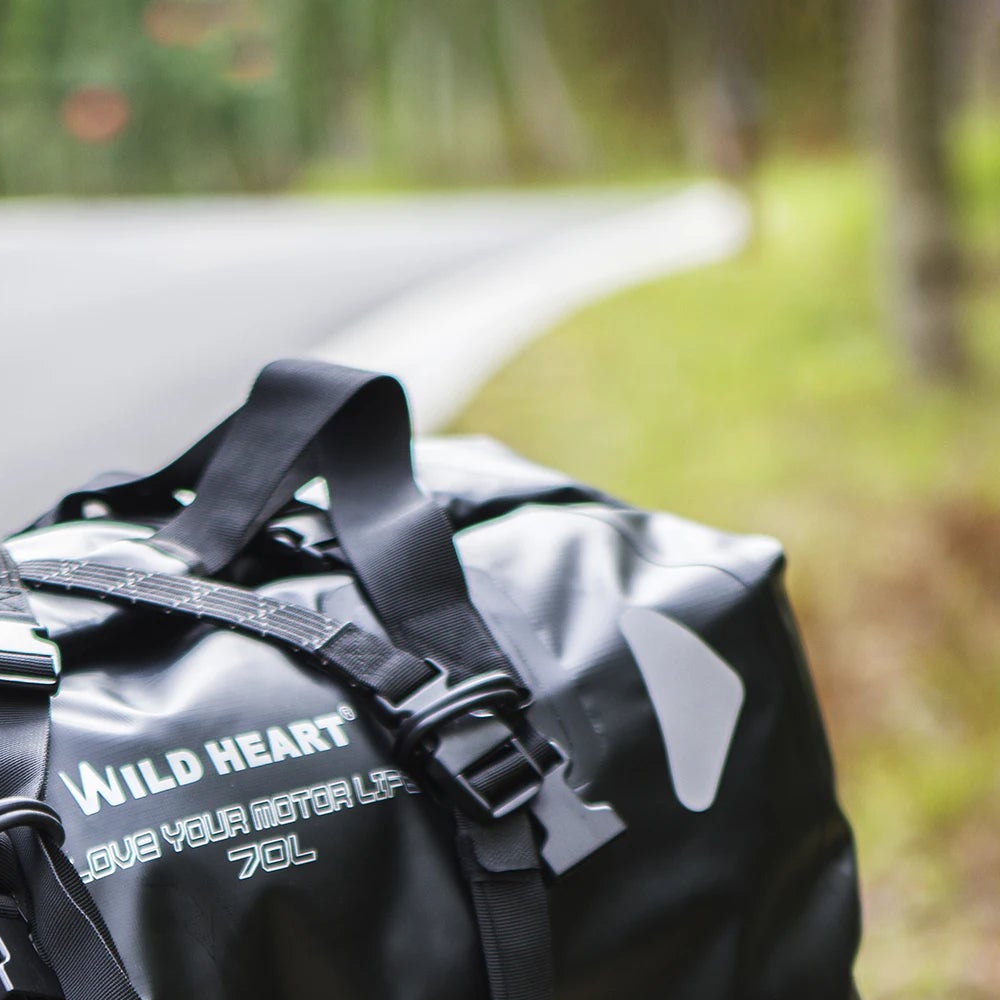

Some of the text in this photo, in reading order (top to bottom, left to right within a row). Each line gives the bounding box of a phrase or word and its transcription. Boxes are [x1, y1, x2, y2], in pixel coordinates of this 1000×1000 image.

[58, 750, 204, 816] WILD
[160, 805, 250, 853] YOUR
[250, 780, 354, 831] MOTOR
[227, 834, 317, 880] 70L
